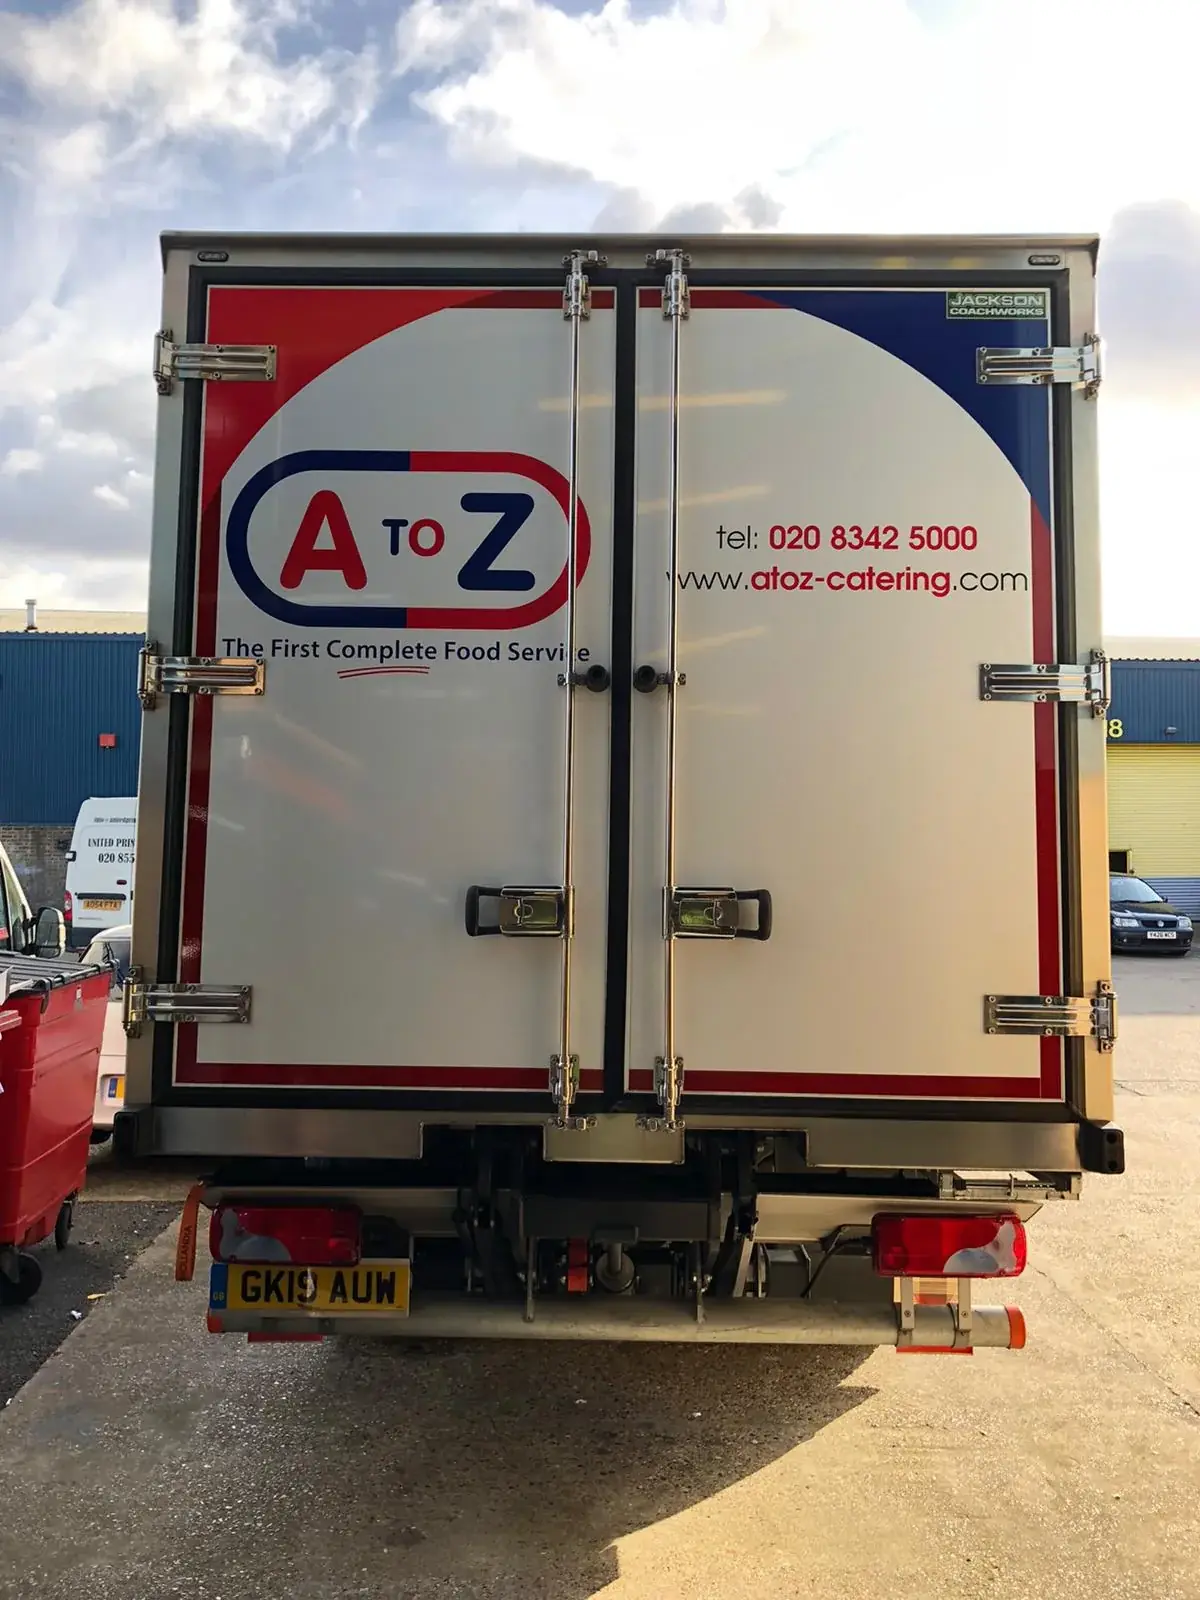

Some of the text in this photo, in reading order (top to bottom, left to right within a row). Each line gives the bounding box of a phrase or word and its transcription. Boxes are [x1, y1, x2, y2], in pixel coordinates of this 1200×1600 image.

[951, 295, 1043, 306] JACKSON
[949, 307, 1044, 316] COACHWORKS
[279, 489, 536, 591] A TO Z
[716, 525, 978, 550] tel: 020 8342 5000
[222, 638, 590, 663] The First Complete Food Servie
[1105, 719, 1123, 738] 8
[88, 838, 114, 848] UNITED
[98, 852, 135, 863] 020 855
[241, 1269, 396, 1305] GK19 AUW
